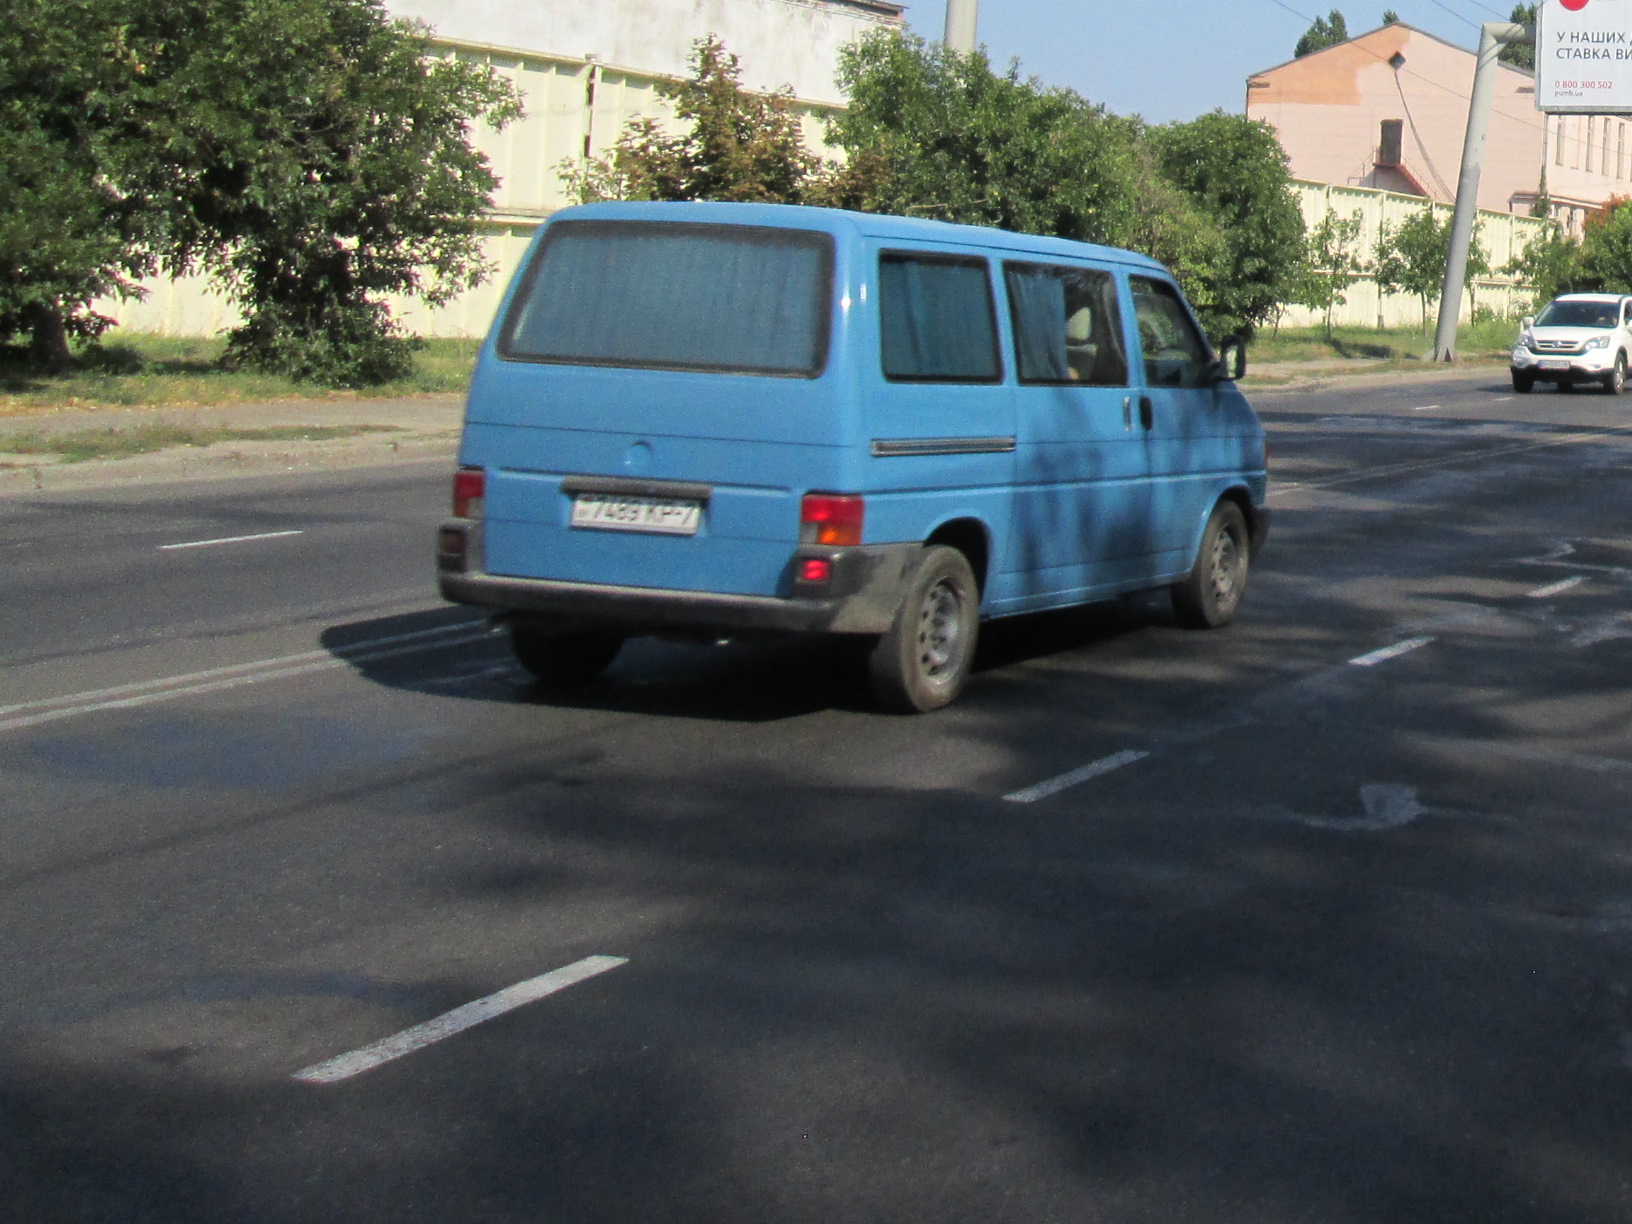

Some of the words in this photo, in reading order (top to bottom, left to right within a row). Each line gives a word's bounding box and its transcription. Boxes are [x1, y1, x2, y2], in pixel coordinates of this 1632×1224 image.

[1556, 31, 1565, 43] У
[1571, 32, 1626, 44] НАШИХ
[1556, 48, 1611, 60] СТАВКА
[1580, 81, 1596, 89] 300
[1597, 81, 1613, 89] 502
